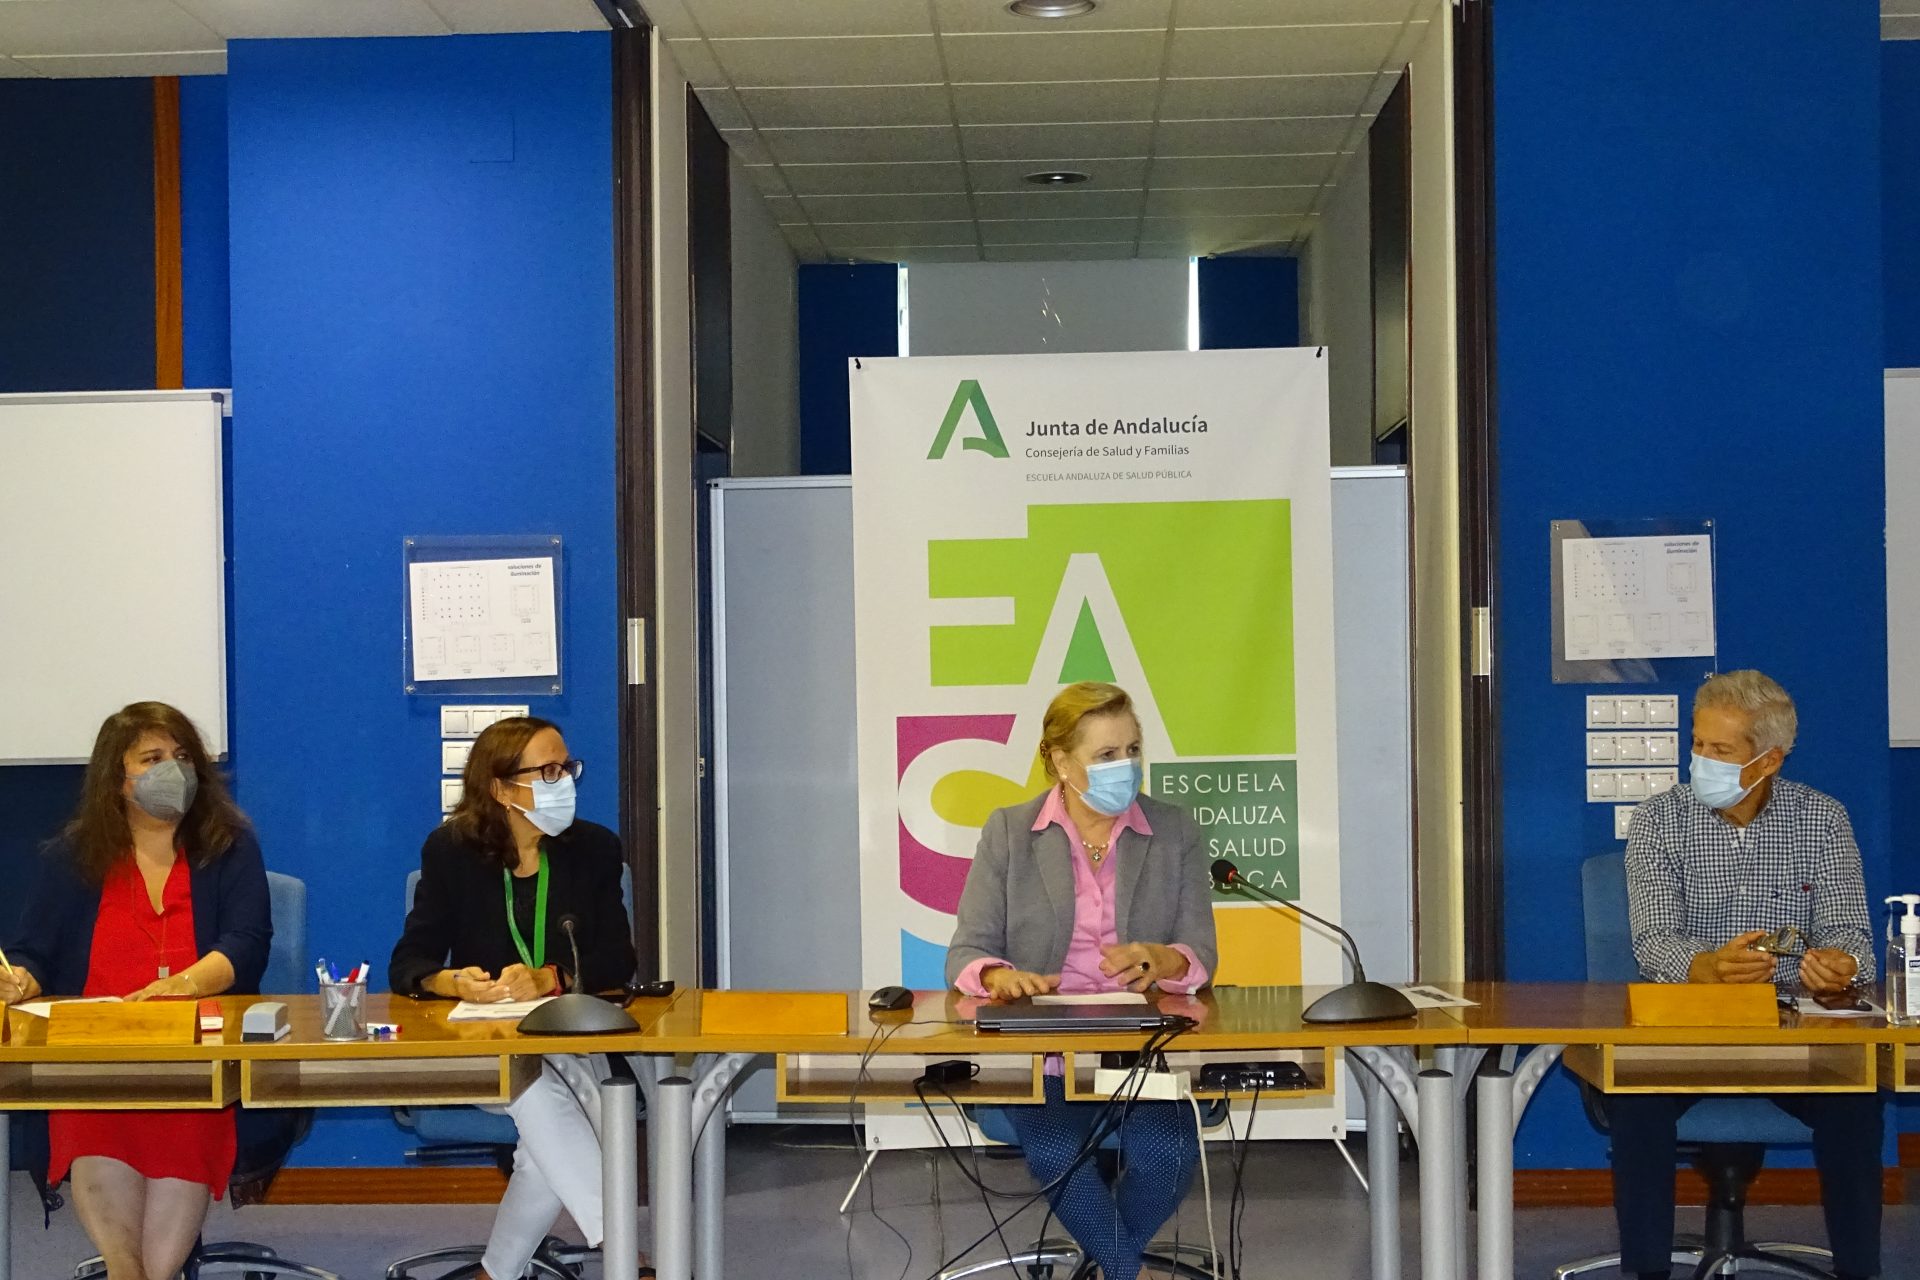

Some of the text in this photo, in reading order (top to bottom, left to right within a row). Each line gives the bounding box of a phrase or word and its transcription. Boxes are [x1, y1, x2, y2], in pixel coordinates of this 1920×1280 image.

[1025, 414, 1208, 437] Junta de Andalucía
[1025, 444, 1190, 461] Consejería de Salud y Familias
[1026, 469, 1192, 482] ESCUELA ANDALUZA DE SALUD PÚBLICA
[1162, 773, 1286, 794] ESCUELA
[1193, 805, 1287, 825] DALUZA
[1208, 837, 1287, 858] SALUD
